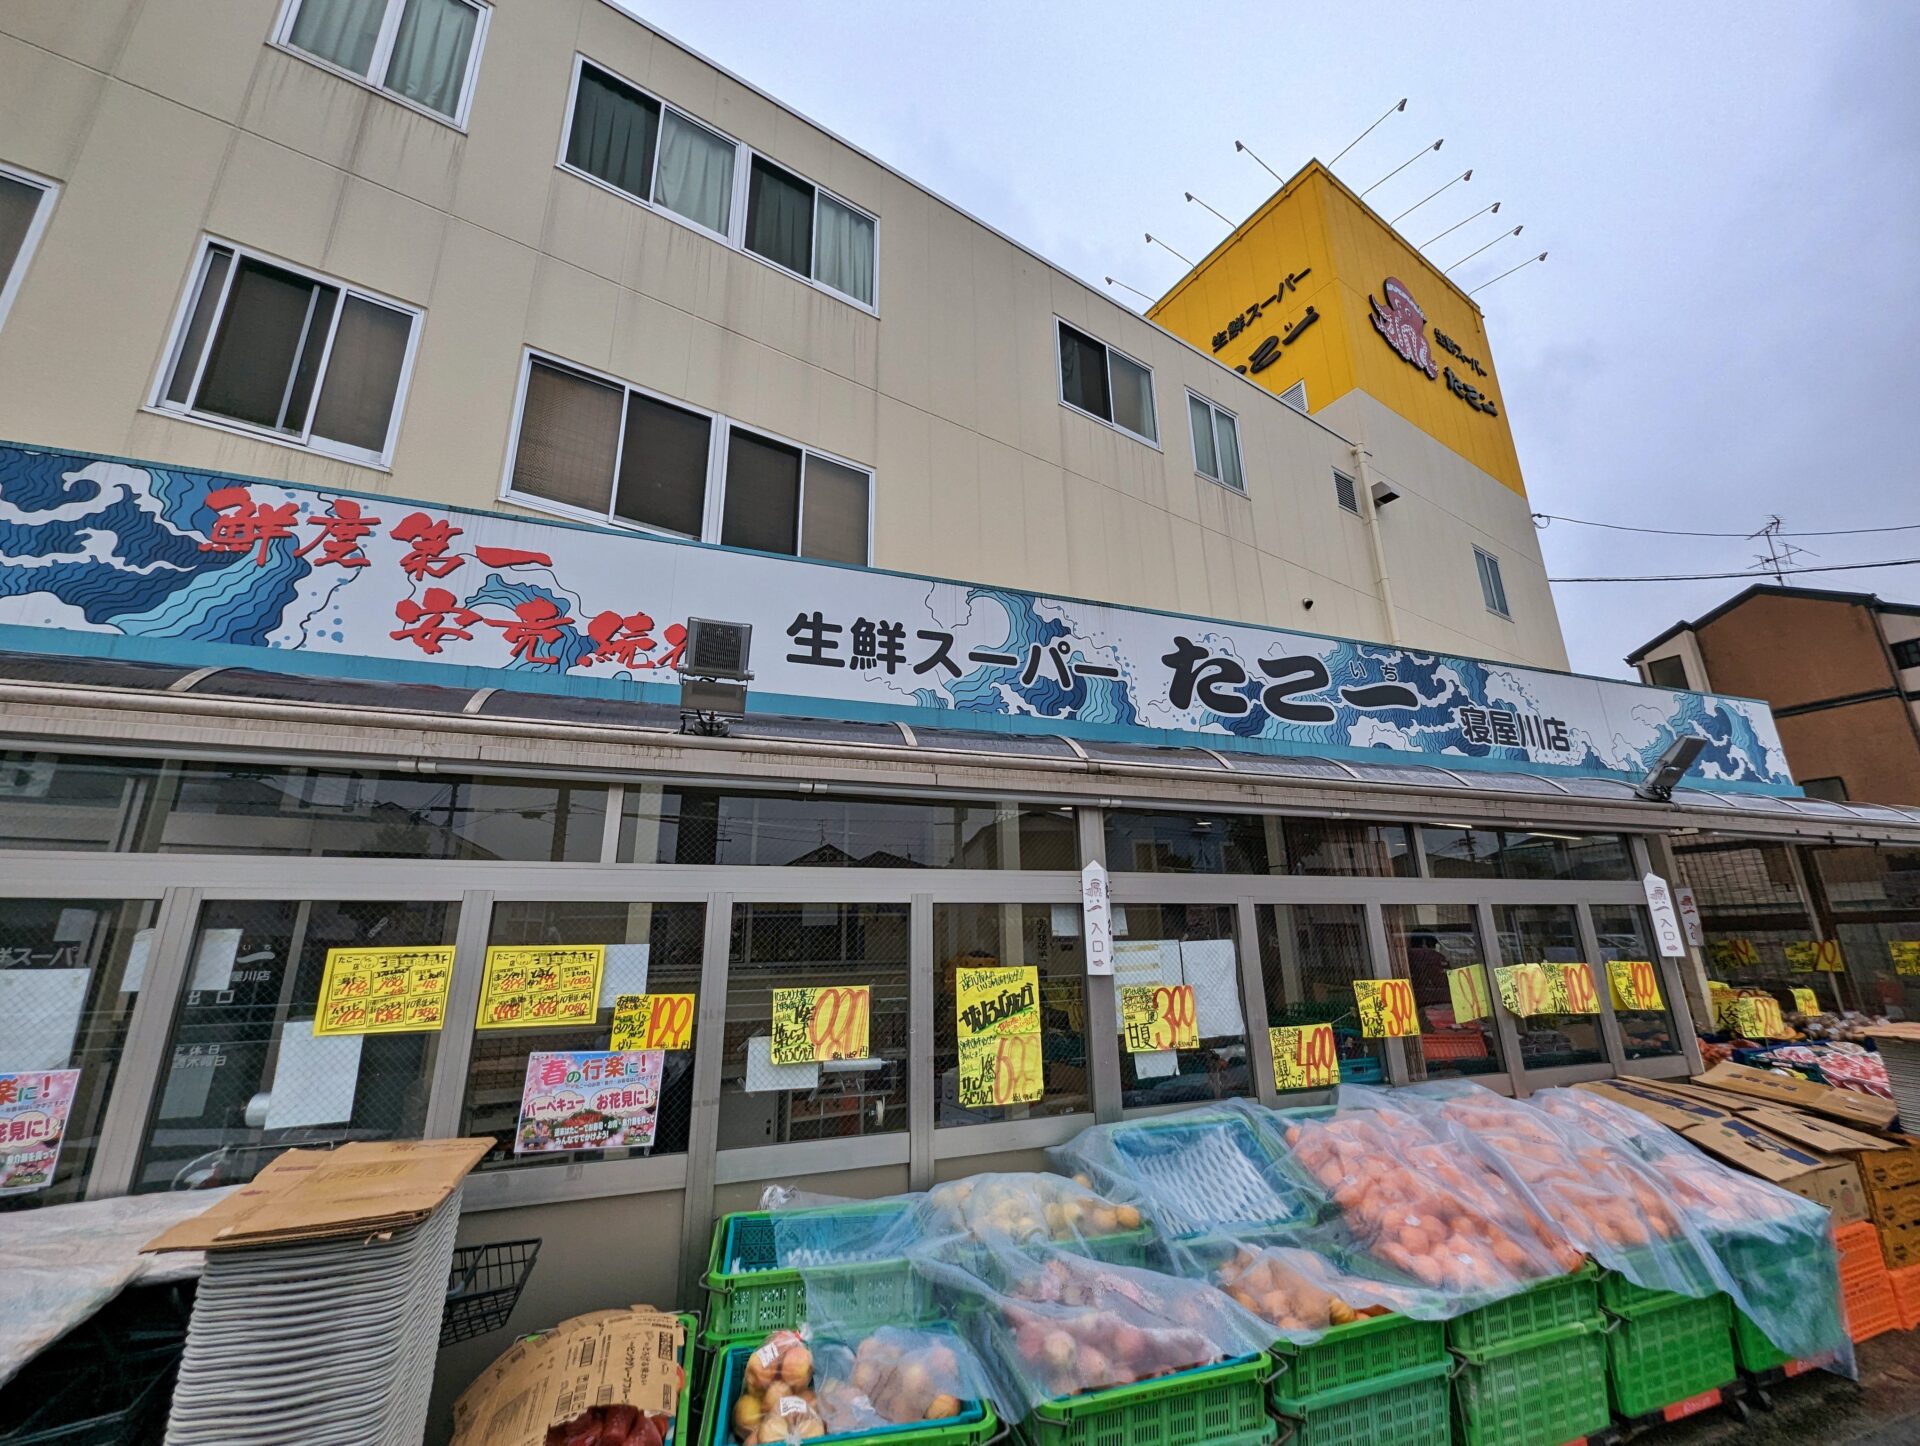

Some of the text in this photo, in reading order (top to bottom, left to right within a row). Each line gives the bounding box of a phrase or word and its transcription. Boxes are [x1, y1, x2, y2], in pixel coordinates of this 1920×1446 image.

[1233, 311, 1320, 375] こ一
[786, 611, 1119, 689] 生鮮スーパー
[1460, 705, 1571, 752] 寝屋川店
[1125, 1021, 1158, 1049] 甘夏
[1152, 985, 1195, 1051] 300
[541, 1054, 647, 1086] 春の行楽に!
[1296, 1026, 1335, 1089] 400
[526, 1098, 586, 1117] バーベキュー
[596, 1089, 649, 1110] お花見に!
